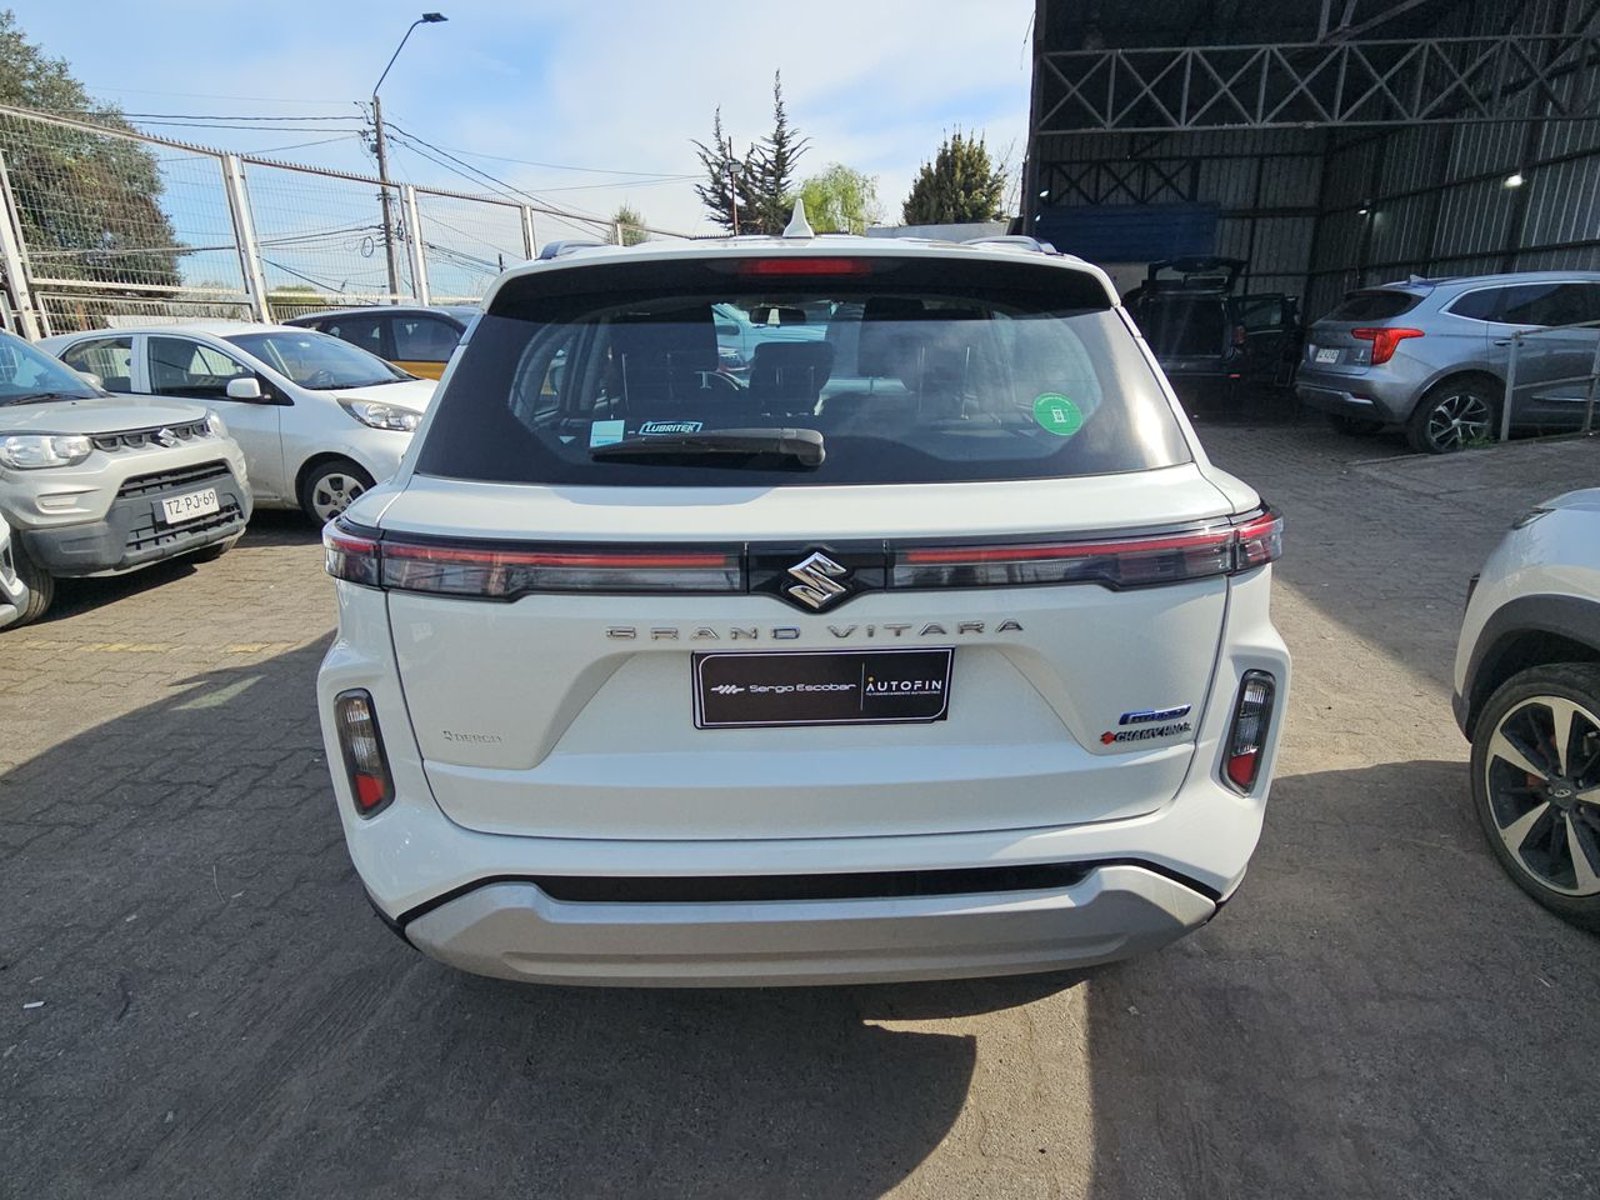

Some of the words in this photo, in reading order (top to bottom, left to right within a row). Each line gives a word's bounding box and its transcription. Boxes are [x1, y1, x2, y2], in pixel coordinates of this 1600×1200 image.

[645, 422, 696, 433] LUBRITEK
[606, 626, 800, 641] GRAND
[827, 618, 1024, 638] VITARA
[749, 684, 795, 694] Sergo
[796, 683, 857, 693] Escobar
[865, 679, 942, 692] AUTOFIN
